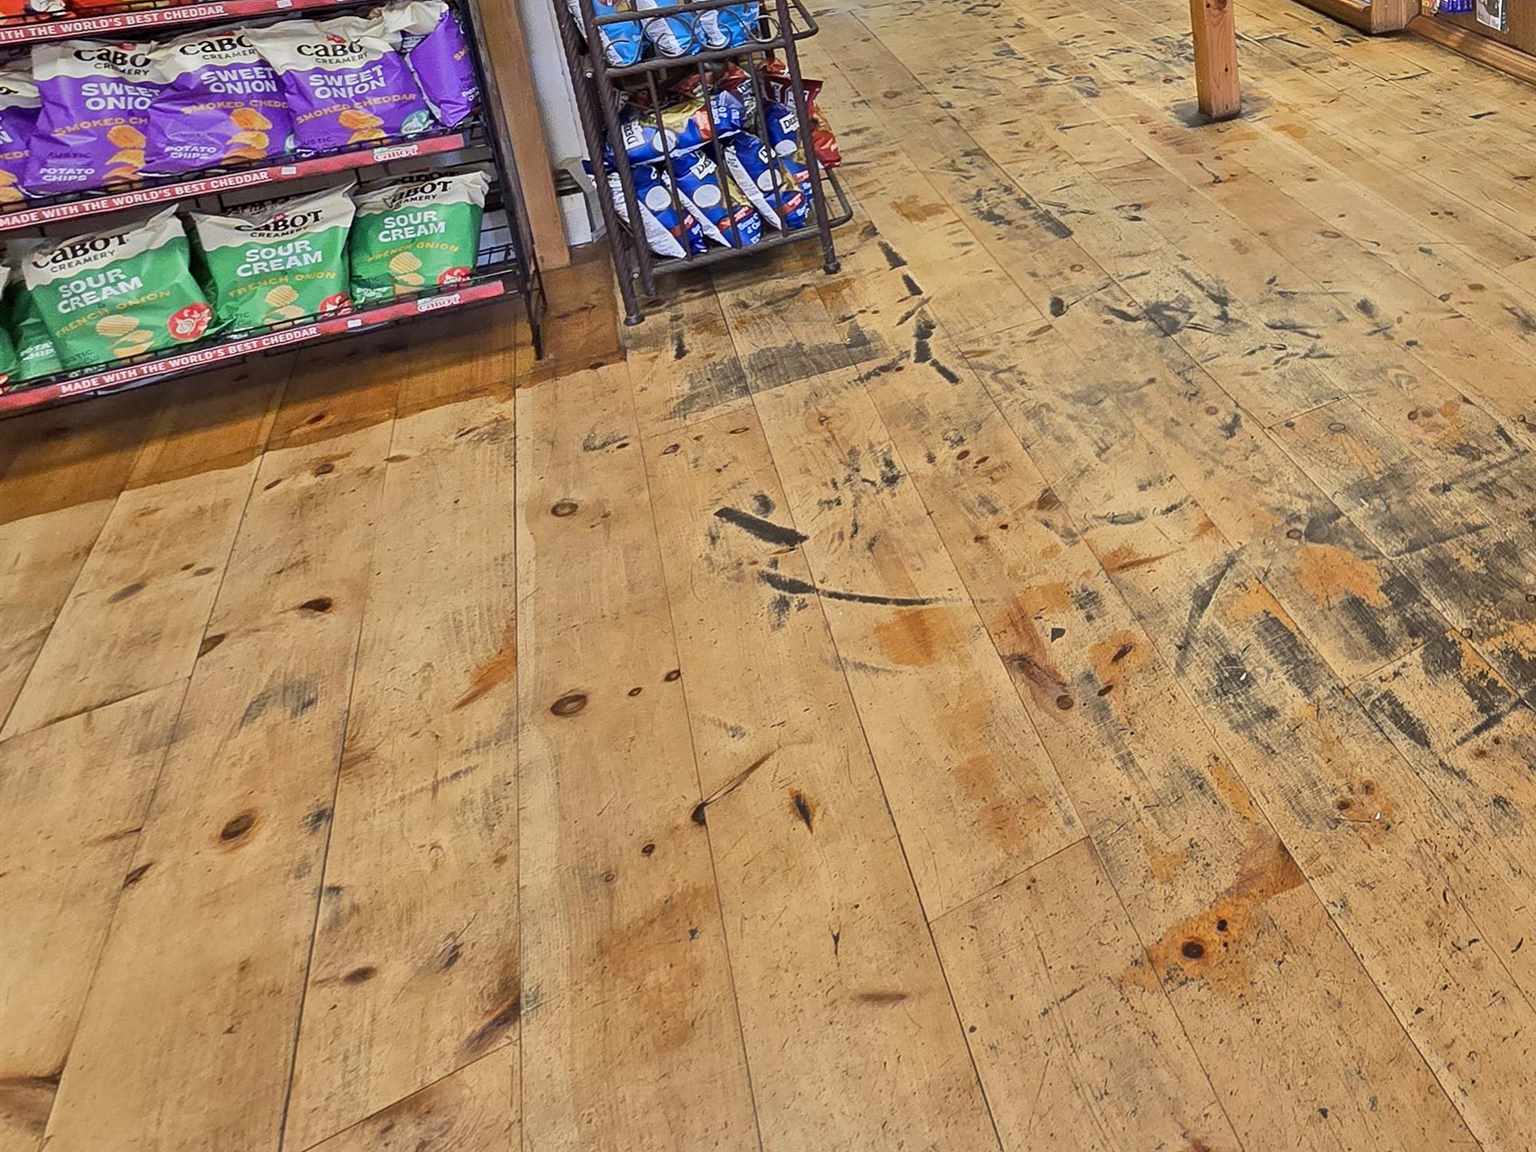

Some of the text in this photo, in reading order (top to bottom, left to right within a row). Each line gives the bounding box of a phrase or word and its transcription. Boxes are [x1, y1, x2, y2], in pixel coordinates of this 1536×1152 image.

[30, 5, 225, 36] THE WORLD'S BEST CHEDDAR
[315, 53, 369, 65] CREAMERY
[201, 66, 275, 84] SWEET
[309, 65, 384, 87] SWEET
[81, 82, 160, 97] SWEET
[209, 78, 278, 95] ONION
[315, 78, 386, 98] ONION
[297, 104, 353, 123] SMOKED
[165, 146, 217, 156] POTATO
[39, 168, 95, 176] POTATO
[42, 174, 87, 182] CHIPS
[0, 171, 269, 228] MADE WITH THE WORLD'S BEST CHEDDAR
[383, 210, 438, 229] SOUR
[378, 222, 446, 243] CREAM
[245, 240, 313, 261] SOUR
[50, 250, 116, 273] CREAMERY
[236, 252, 324, 277] CREAM
[59, 268, 127, 298] SOUR
[58, 277, 143, 314] CREAM
[61, 326, 318, 394] MADE WITH THE WORLD'S BEST CHEDDAR
